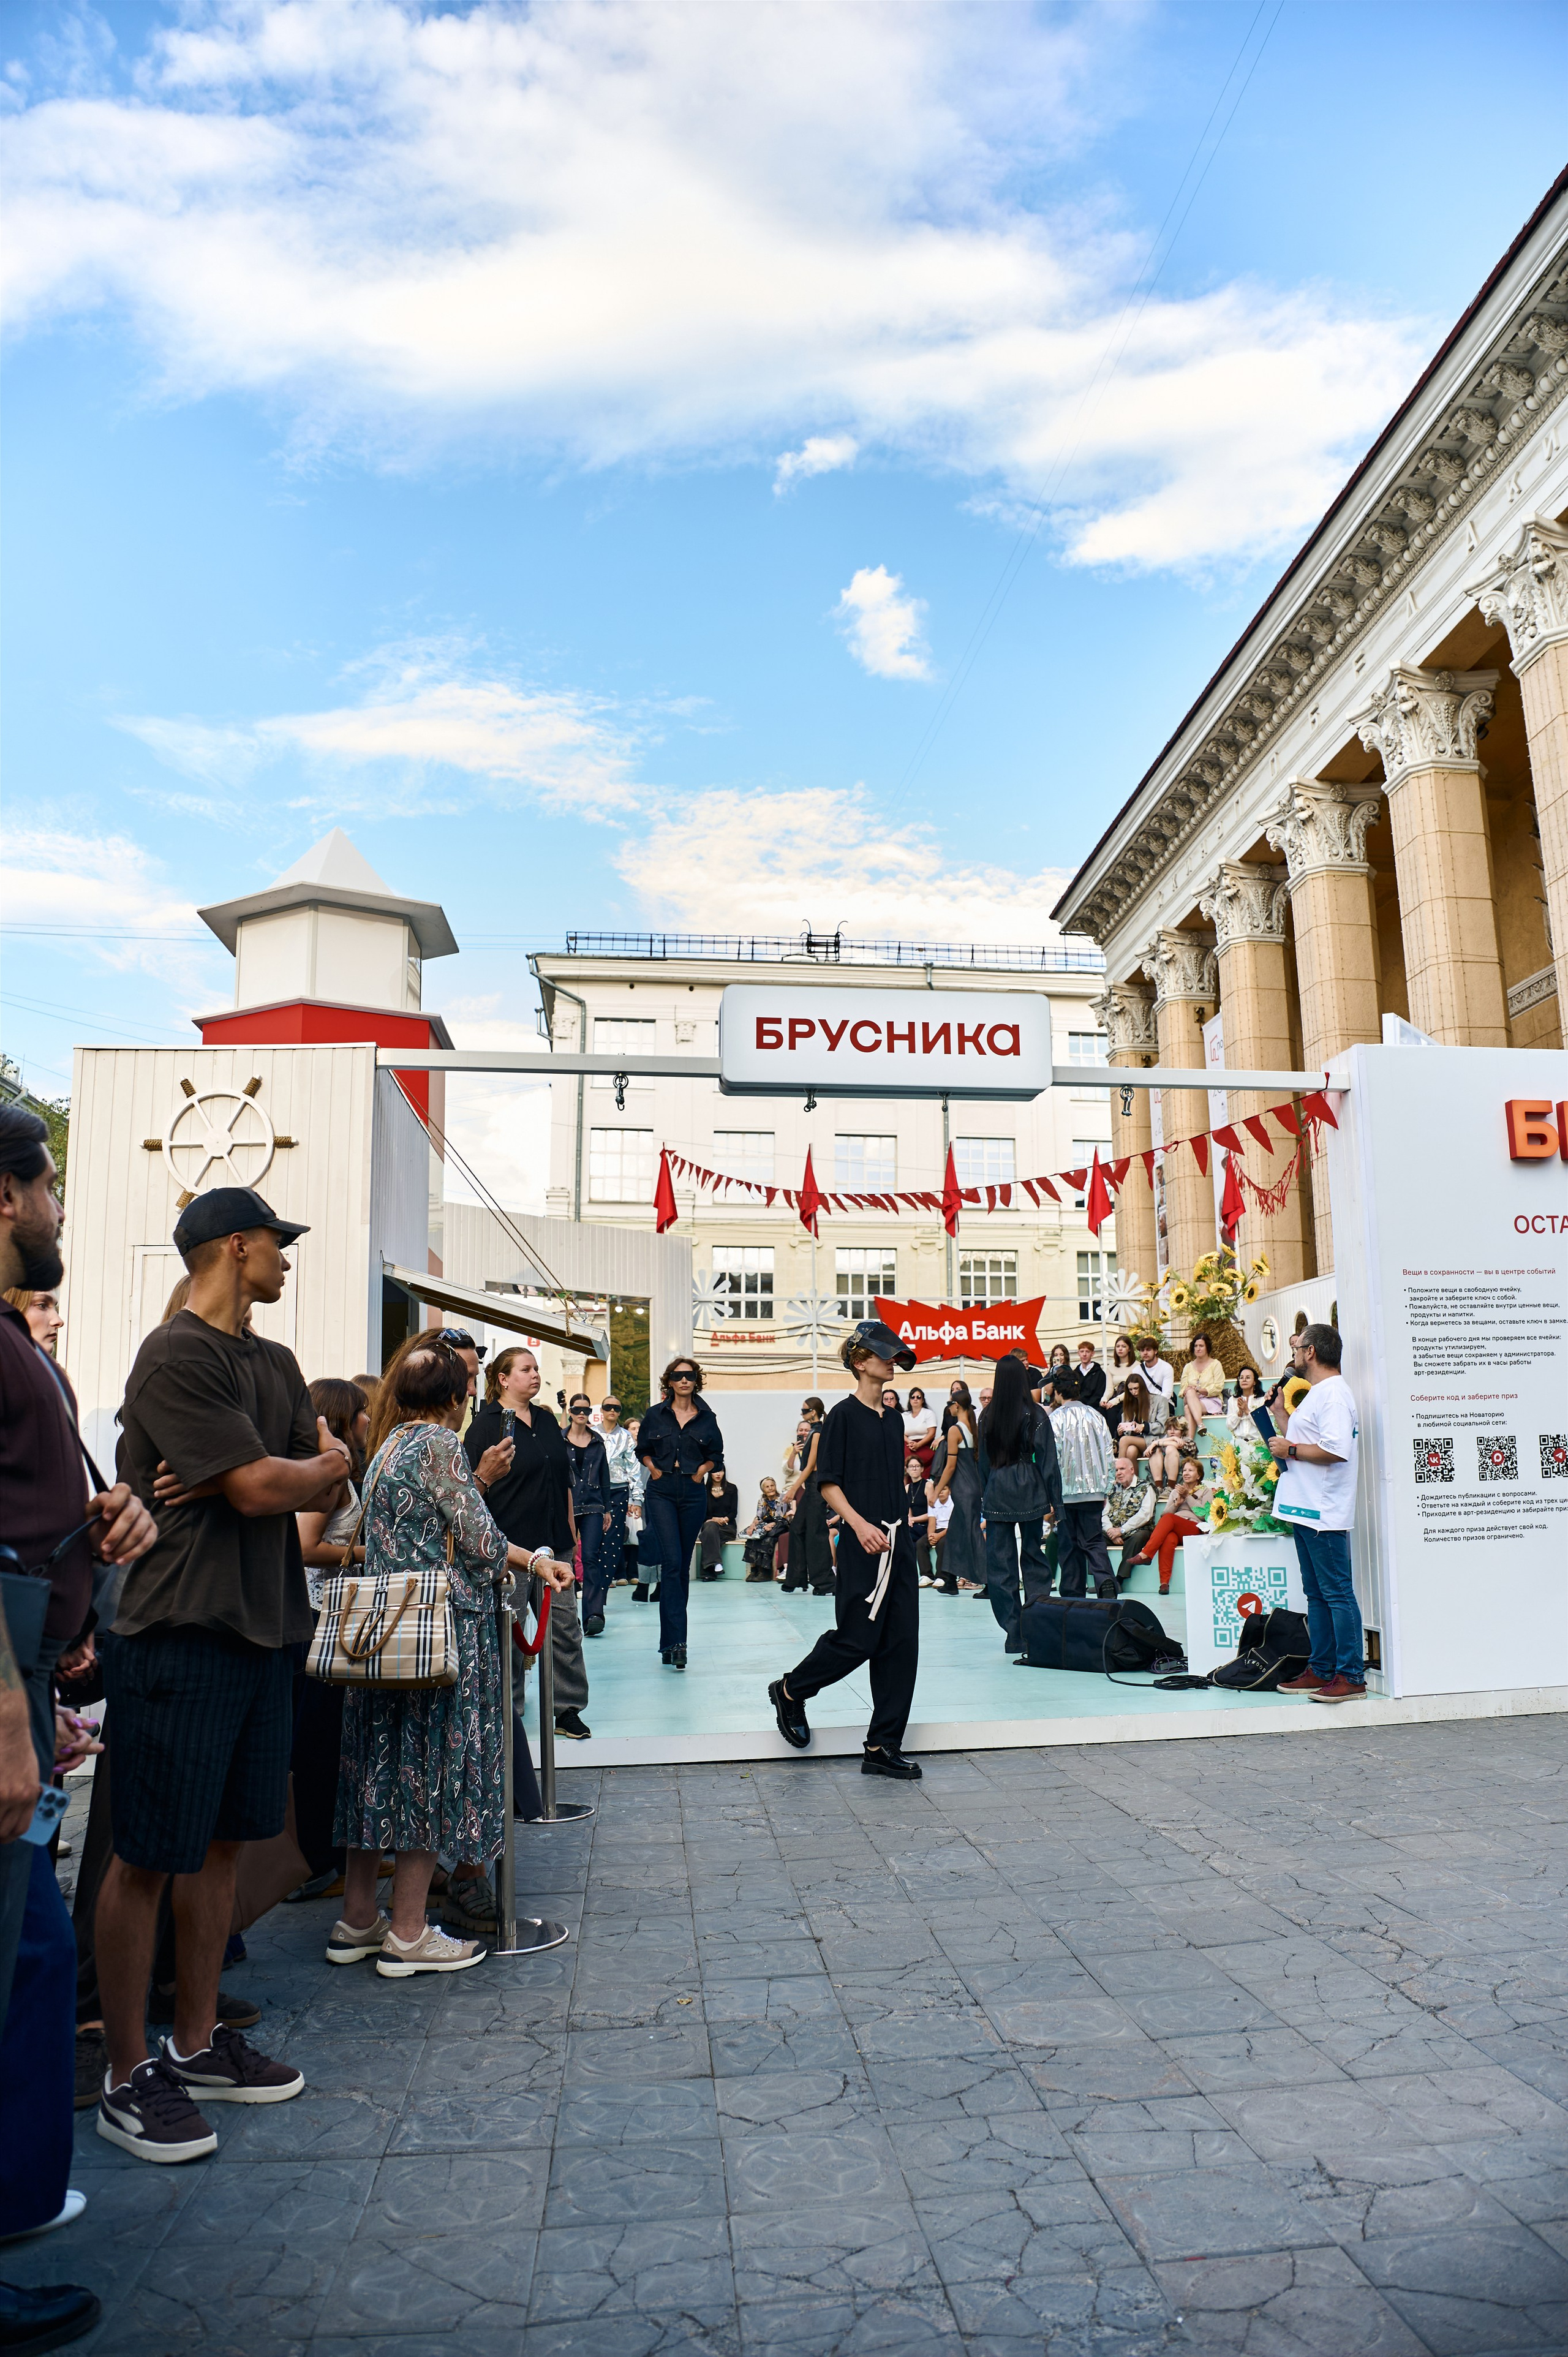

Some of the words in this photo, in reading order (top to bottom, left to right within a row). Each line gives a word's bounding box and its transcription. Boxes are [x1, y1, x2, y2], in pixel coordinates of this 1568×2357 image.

[1505, 1099, 1568, 1160] Б
[1402, 1268, 1422, 1277] Вещи
[710, 1331, 746, 1344] Альфа
[748, 1332, 775, 1343] Банк
[898, 1321, 968, 1345] Альфа
[972, 1321, 1026, 1340] Банк
[1410, 1393, 1445, 1403] Соберите
[1467, 1392, 1500, 1401] заберите
[1420, 1493, 1457, 1502] Дождитесь
[1460, 1499, 1486, 1508] каждый
[1463, 1508, 1516, 1517] арт-резиденцию
[1423, 1527, 1436, 1536] Для
